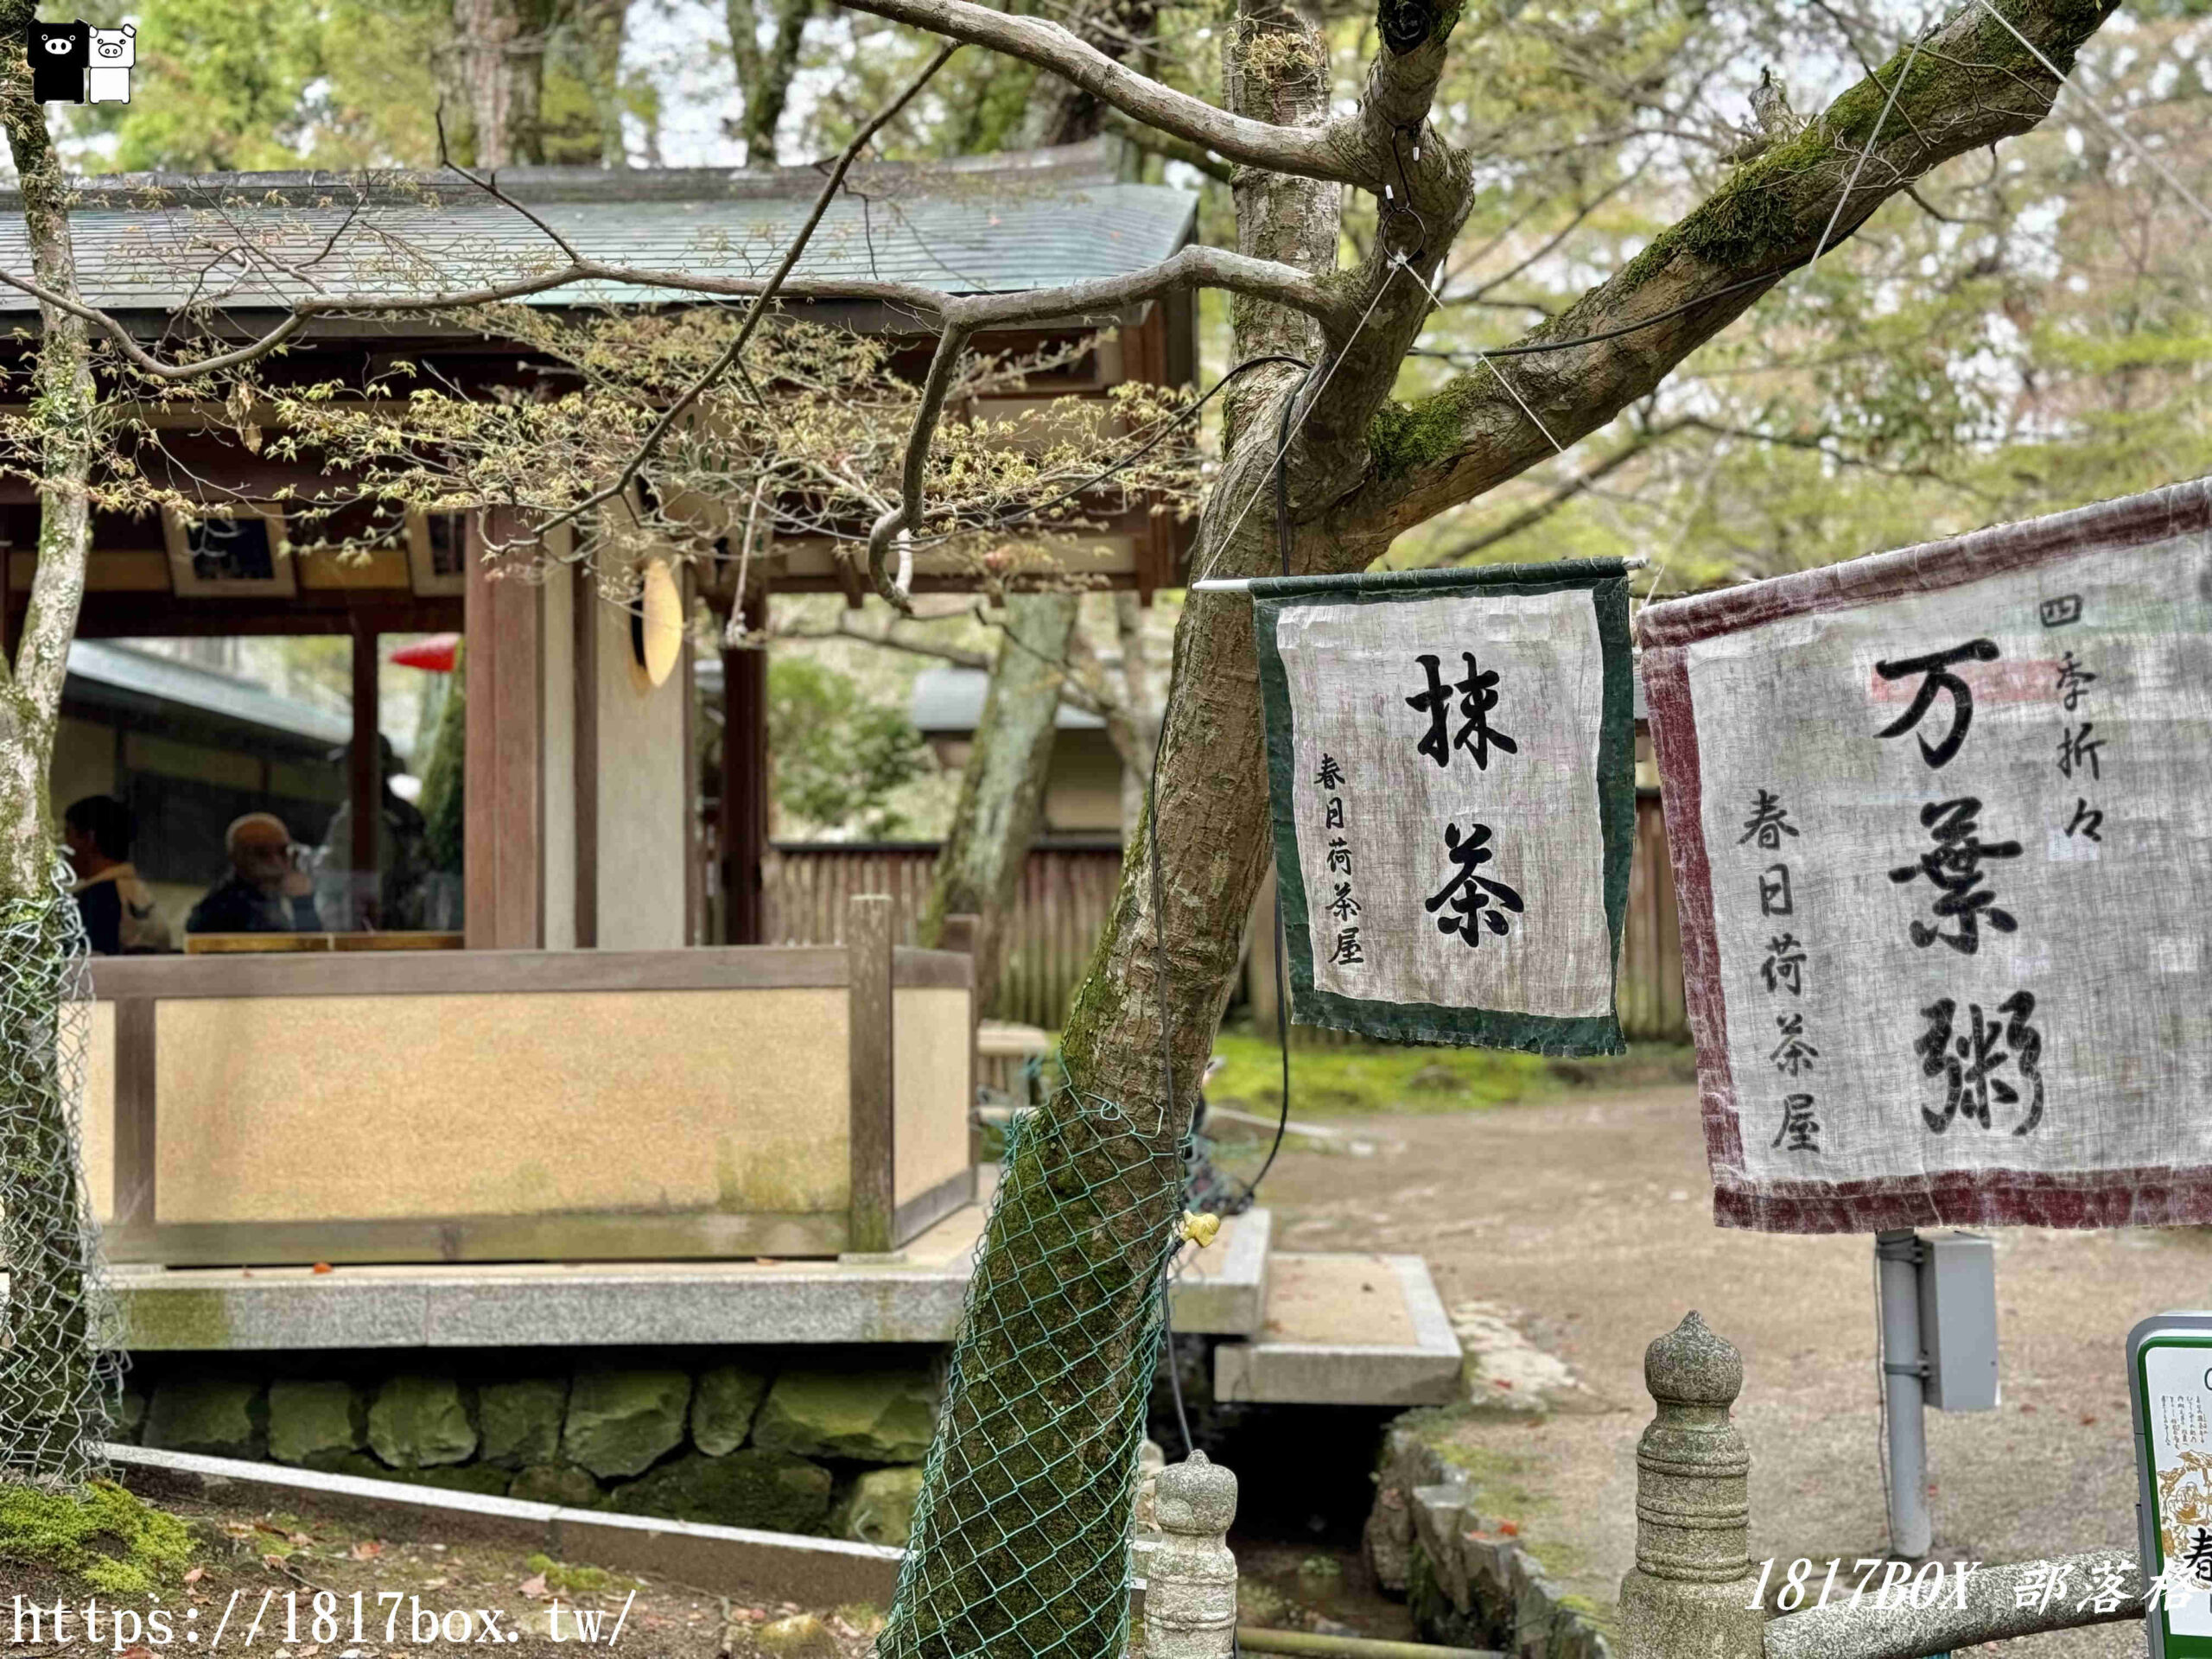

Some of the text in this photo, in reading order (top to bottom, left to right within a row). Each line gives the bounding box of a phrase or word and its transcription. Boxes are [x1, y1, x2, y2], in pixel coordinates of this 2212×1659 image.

[1313, 753, 1364, 966] 春日荷茶屋
[1405, 652, 1524, 948] 抹茶
[2040, 594, 2107, 842] 四季折々
[1737, 789, 1821, 1154] 春日荷茶屋
[1875, 638, 2046, 1137] 万葉粥
